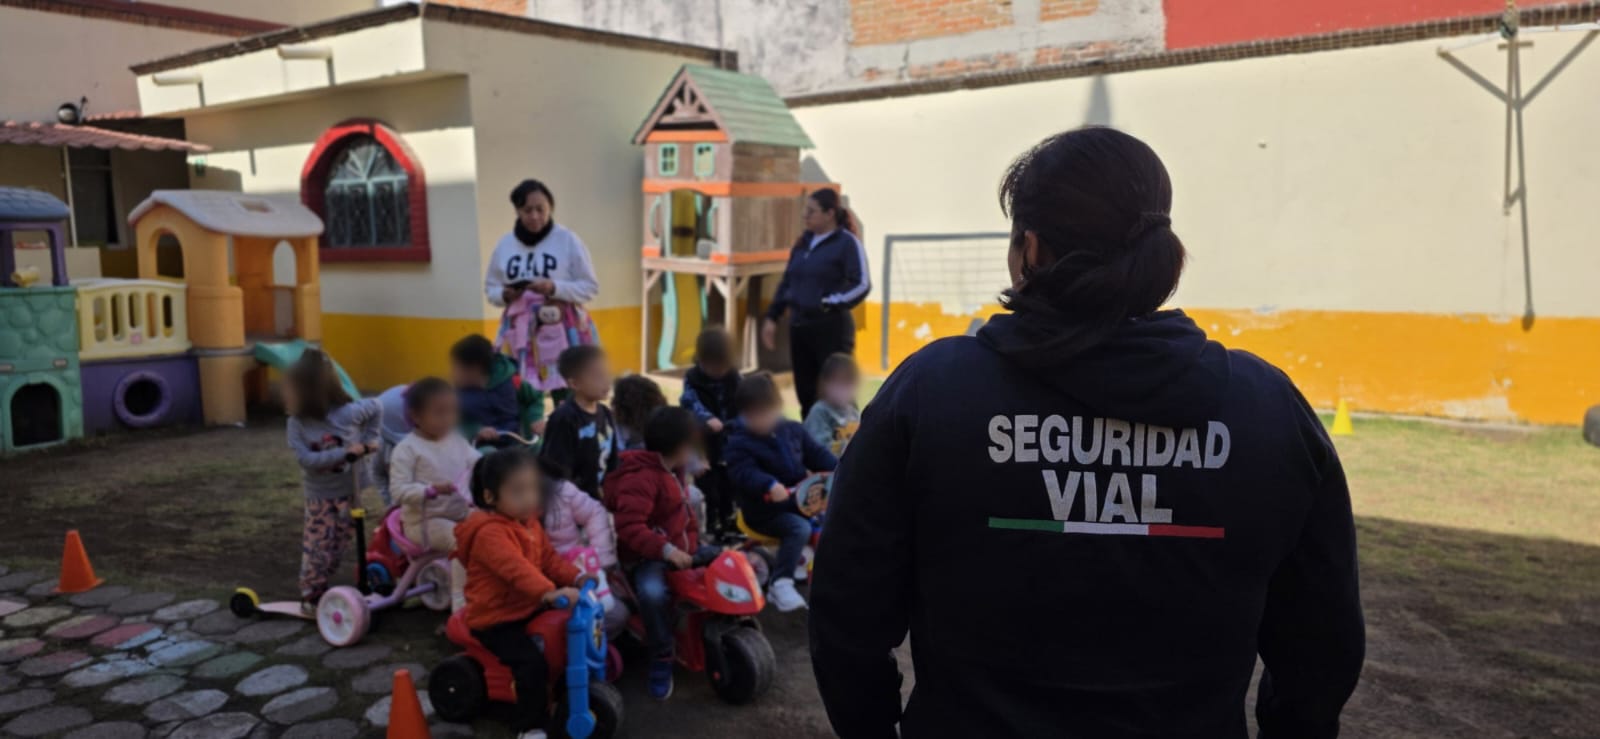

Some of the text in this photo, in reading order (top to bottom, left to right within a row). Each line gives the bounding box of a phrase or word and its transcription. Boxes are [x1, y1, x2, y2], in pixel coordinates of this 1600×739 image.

[506, 252, 557, 280] GAP
[987, 414, 1231, 469] SEGURIDAD
[1041, 469, 1173, 524] VIAL
